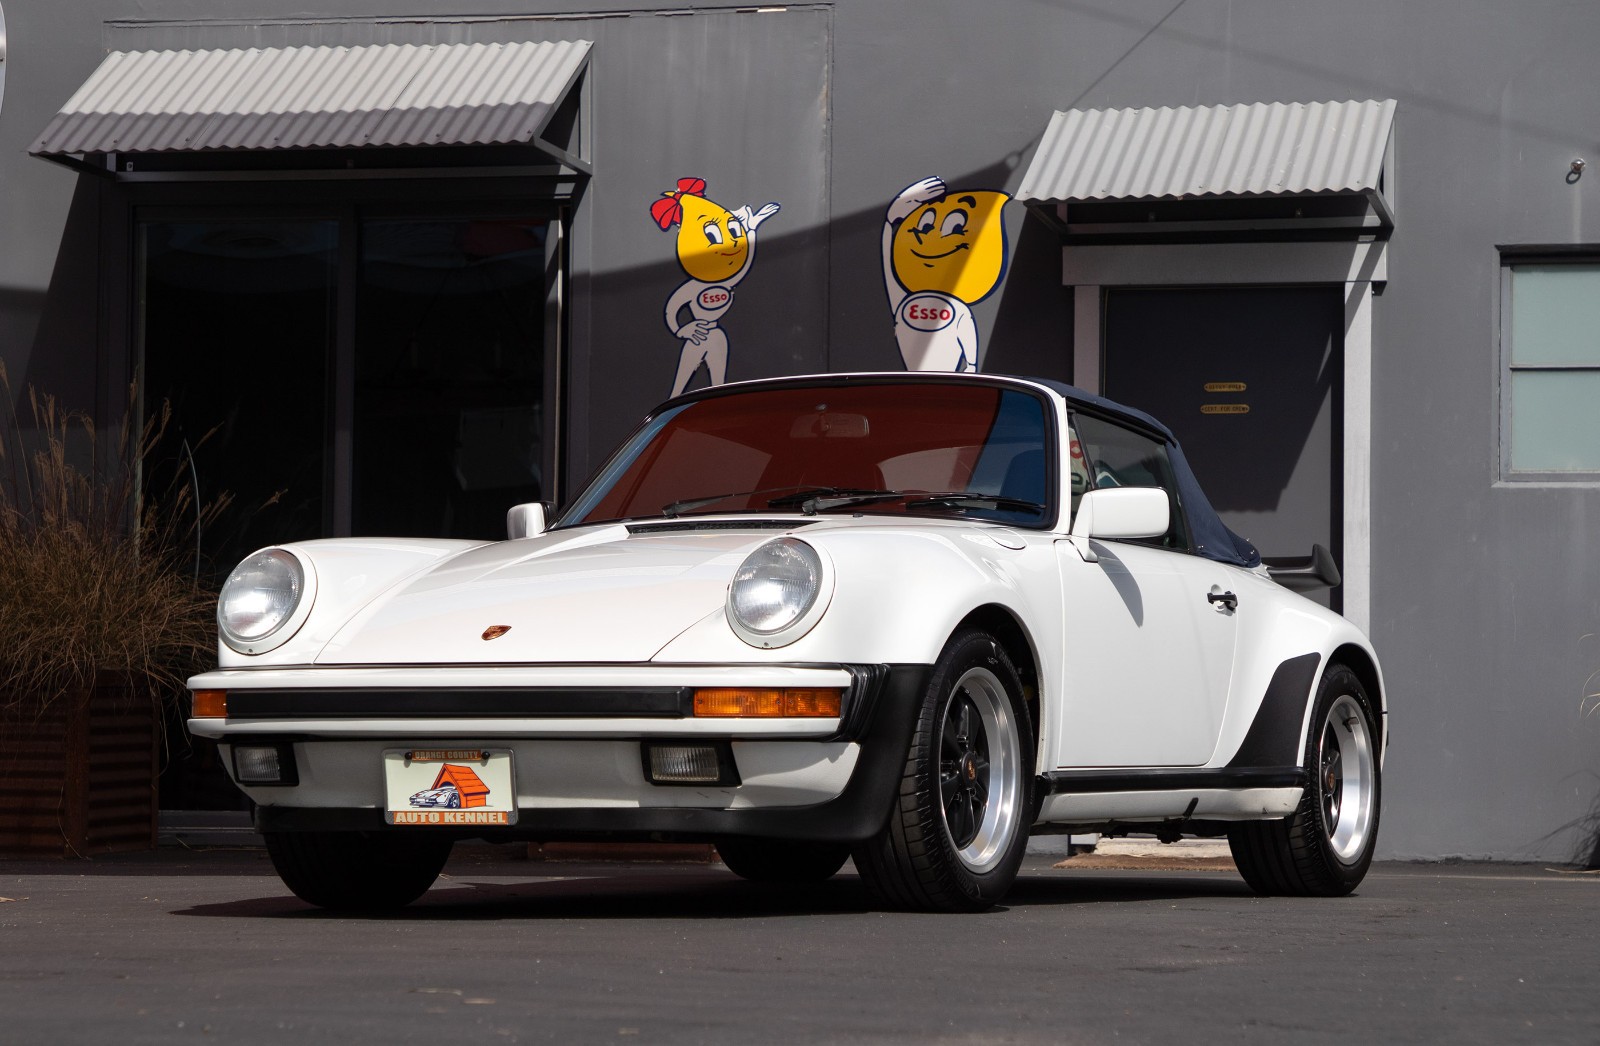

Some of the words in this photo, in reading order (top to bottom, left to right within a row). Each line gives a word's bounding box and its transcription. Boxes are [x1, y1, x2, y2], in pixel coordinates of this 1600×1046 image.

[414, 751, 446, 759] ORANGE
[447, 751, 478, 759] COUNTY
[395, 812, 440, 823] AUTO
[444, 812, 505, 823] KENNEL
